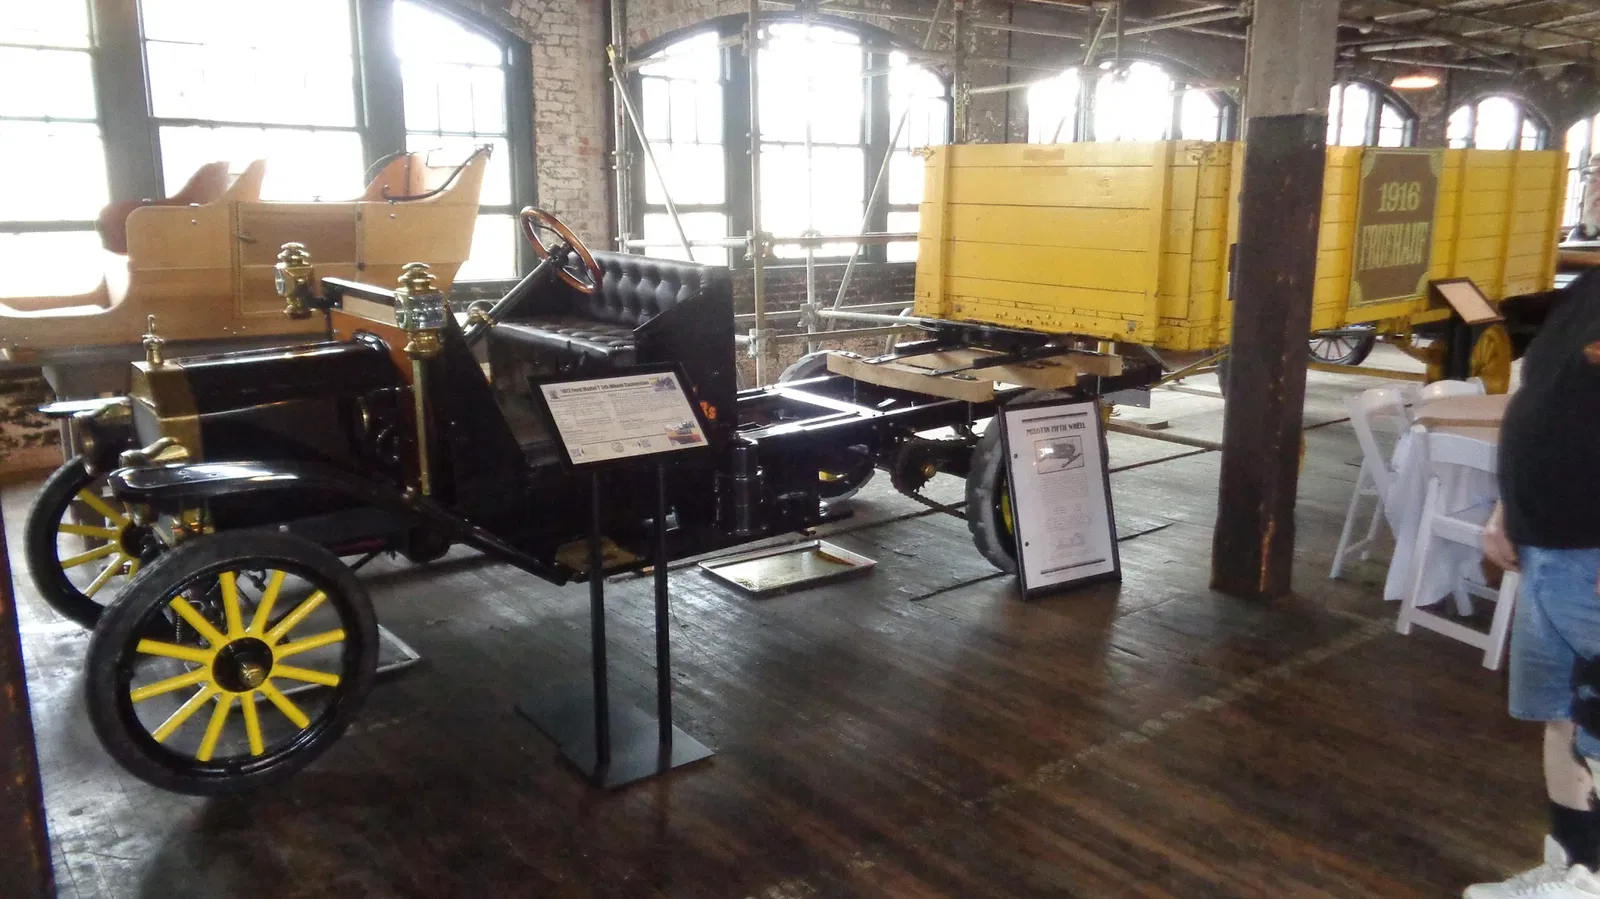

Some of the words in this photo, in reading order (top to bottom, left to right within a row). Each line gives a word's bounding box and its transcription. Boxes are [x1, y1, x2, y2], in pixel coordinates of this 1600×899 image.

[1377, 181, 1421, 213] 1916
[1051, 424, 1067, 432] FIFTH
[1068, 422, 1086, 430] WHEEL
